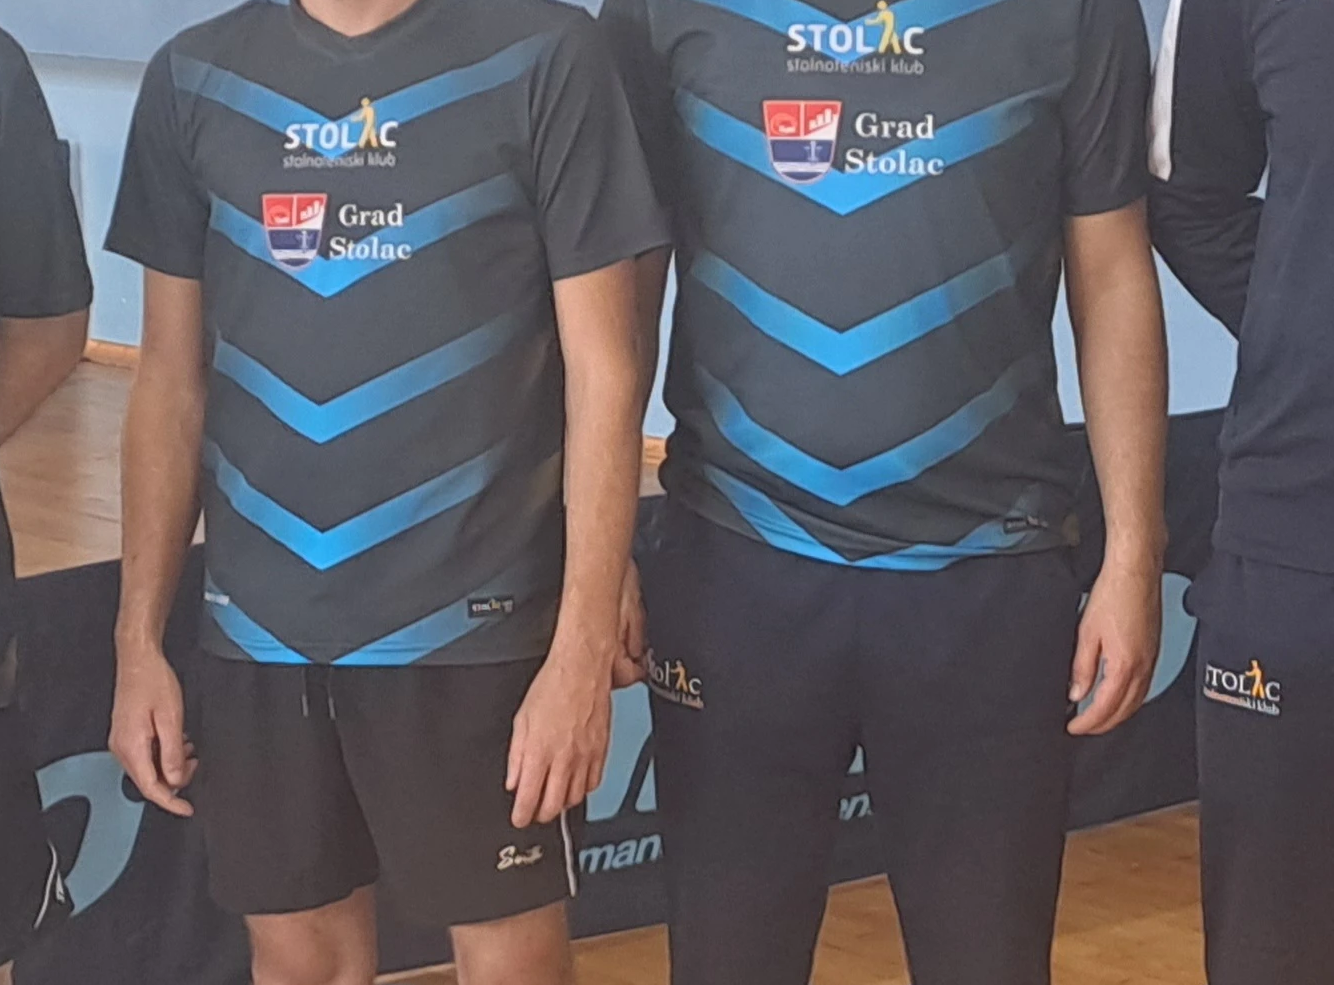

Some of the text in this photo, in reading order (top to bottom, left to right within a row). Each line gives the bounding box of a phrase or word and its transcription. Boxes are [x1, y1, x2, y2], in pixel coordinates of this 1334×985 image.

[786, 0, 925, 55] STOLAC
[890, 58, 925, 76] klub
[283, 97, 399, 150] STOLAC
[855, 112, 934, 139] Grad
[845, 147, 944, 176] Stolac
[338, 203, 404, 227] Grad
[329, 235, 413, 260] Stolac
